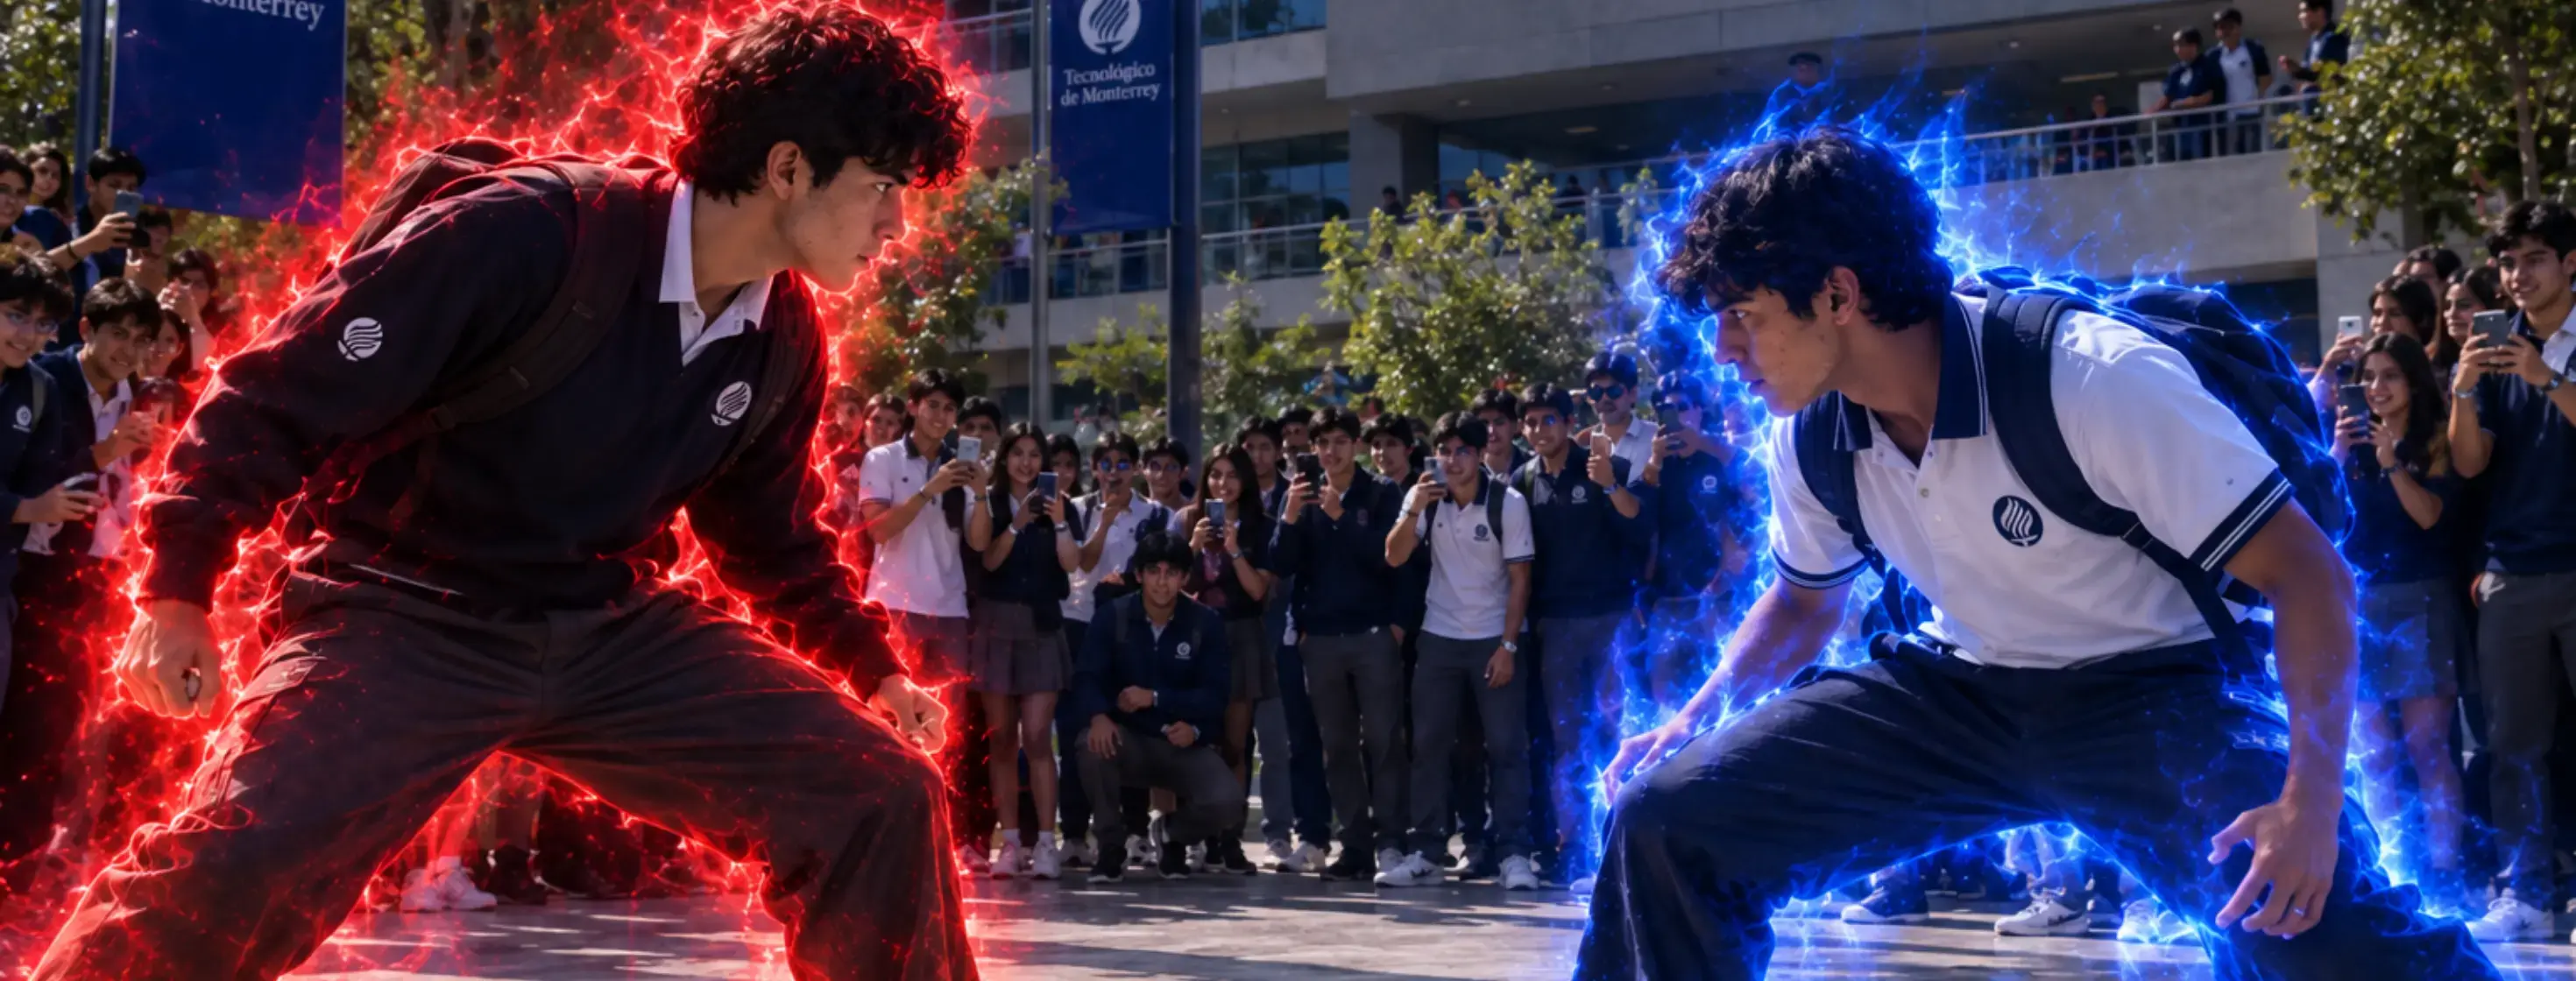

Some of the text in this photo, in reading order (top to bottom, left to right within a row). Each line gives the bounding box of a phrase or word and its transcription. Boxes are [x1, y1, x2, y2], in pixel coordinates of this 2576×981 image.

[202, 0, 324, 31] nterrey
[1063, 62, 1156, 85] Tecnológico
[1060, 84, 1159, 106] de Monterrey
